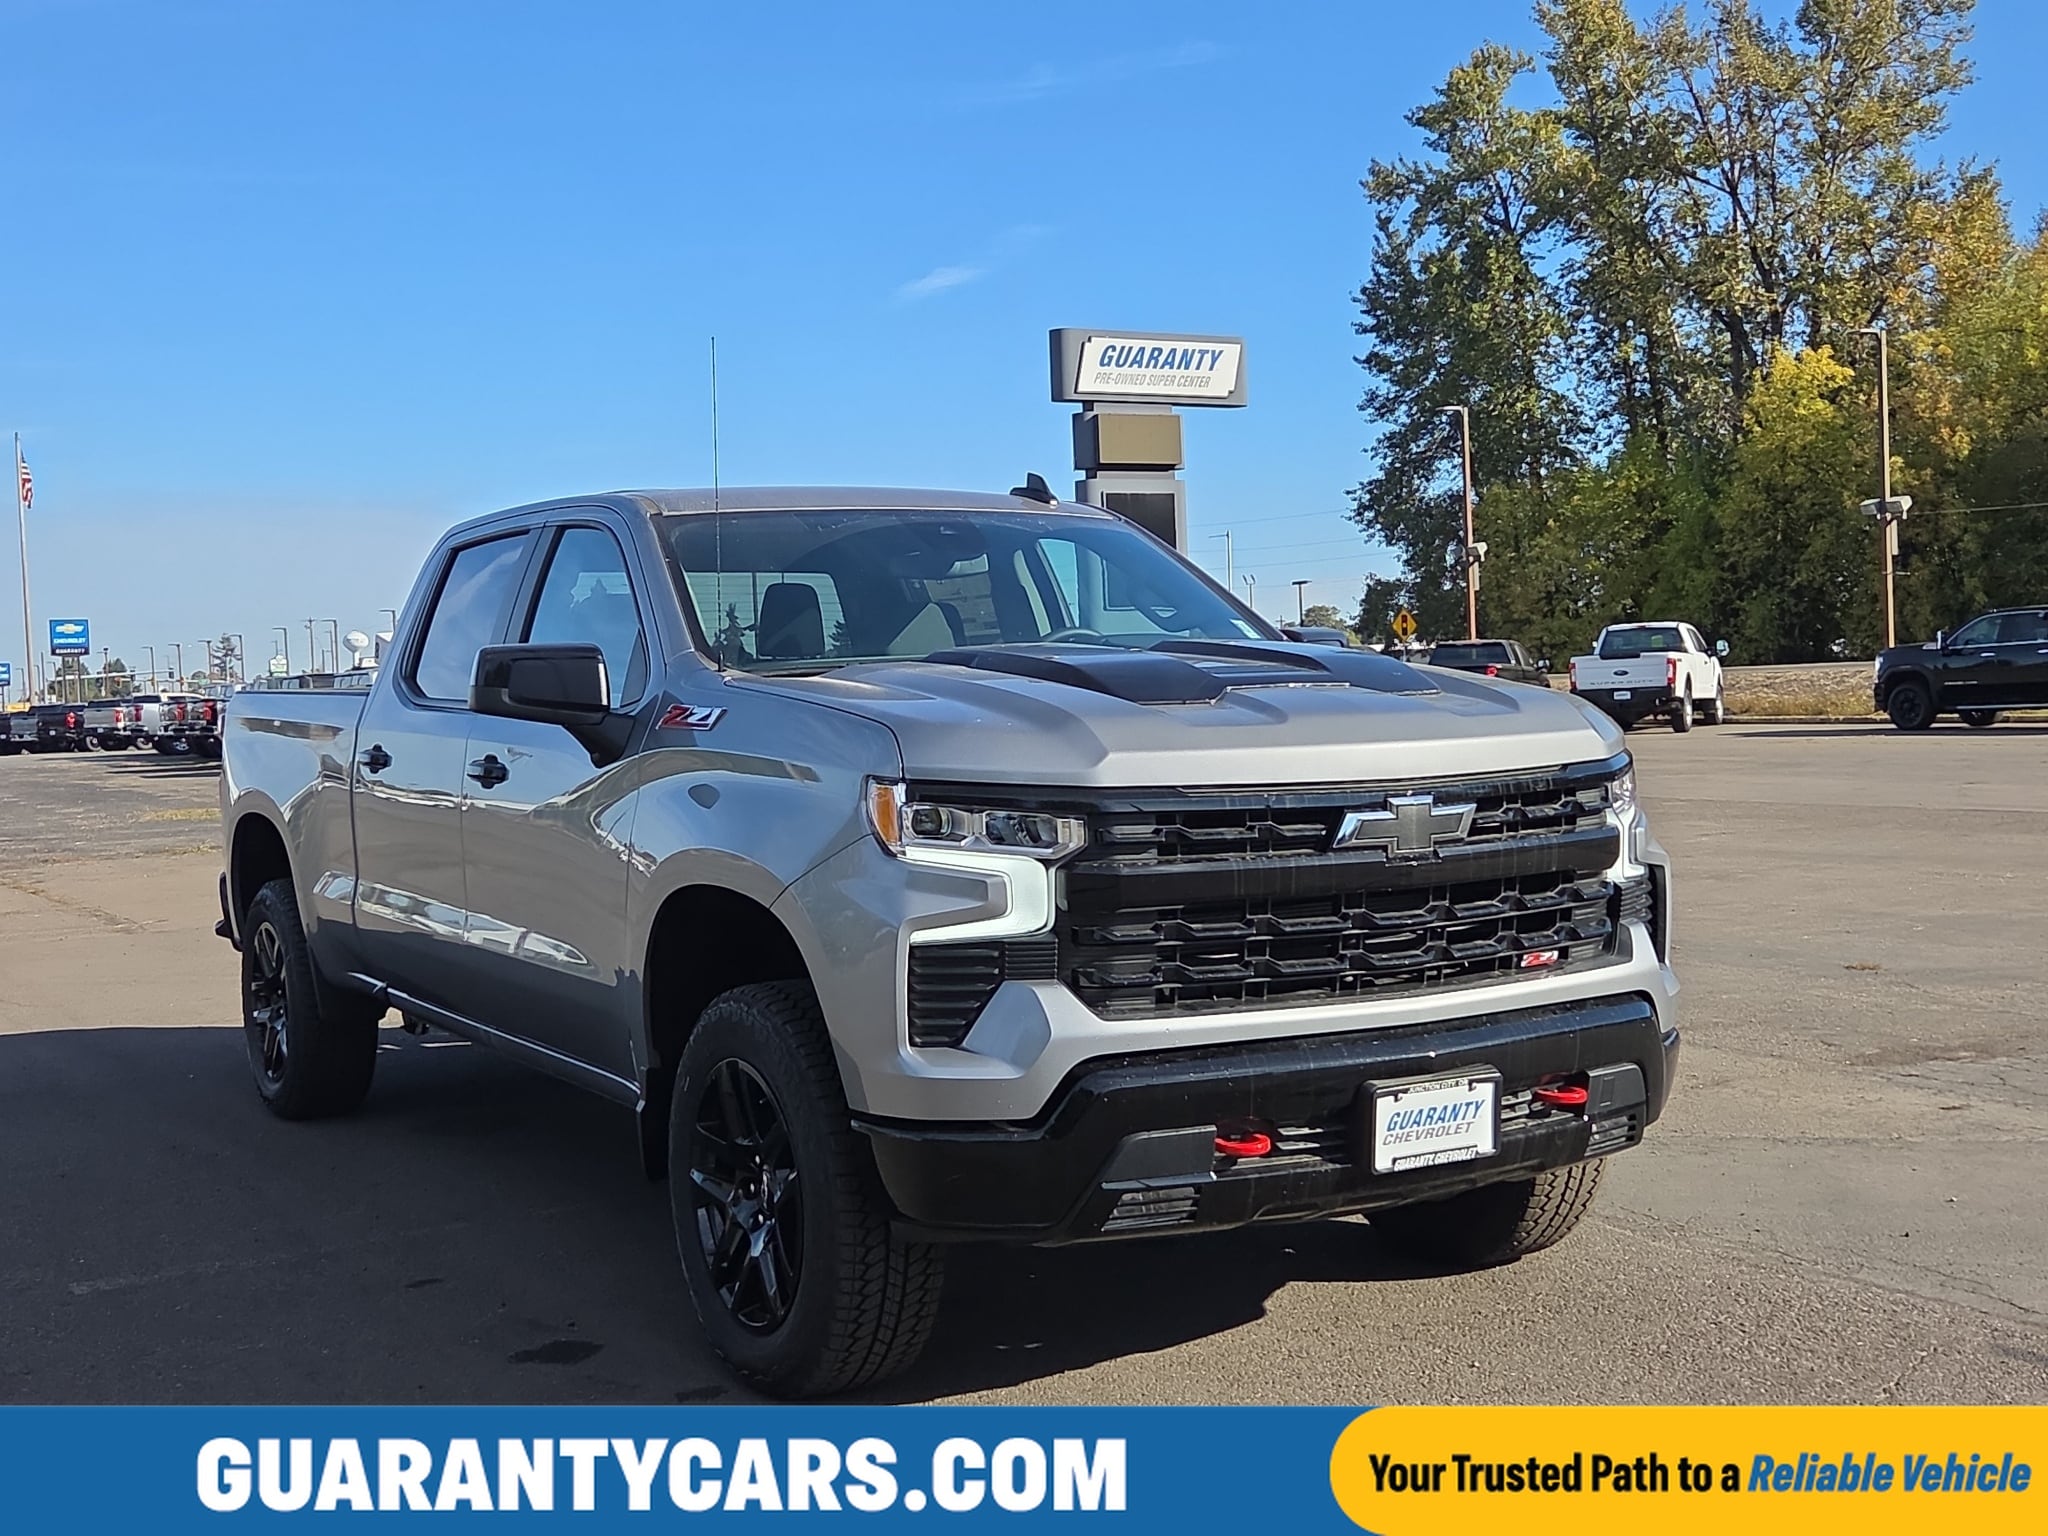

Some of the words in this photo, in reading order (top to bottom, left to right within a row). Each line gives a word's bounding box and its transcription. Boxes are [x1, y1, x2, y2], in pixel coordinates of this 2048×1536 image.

[1099, 344, 1224, 371] GUARANTY
[1094, 372, 1146, 386] PRE-OWNED
[1147, 374, 1175, 387] SUPER
[1176, 375, 1211, 388] CENTER
[656, 704, 727, 730] Z71
[1387, 1099, 1486, 1132] GUARANTY
[1382, 1121, 1474, 1146] CHEVROLET
[1393, 1154, 1435, 1172] GUARANTY
[1434, 1147, 1477, 1165] CHEVROLET
